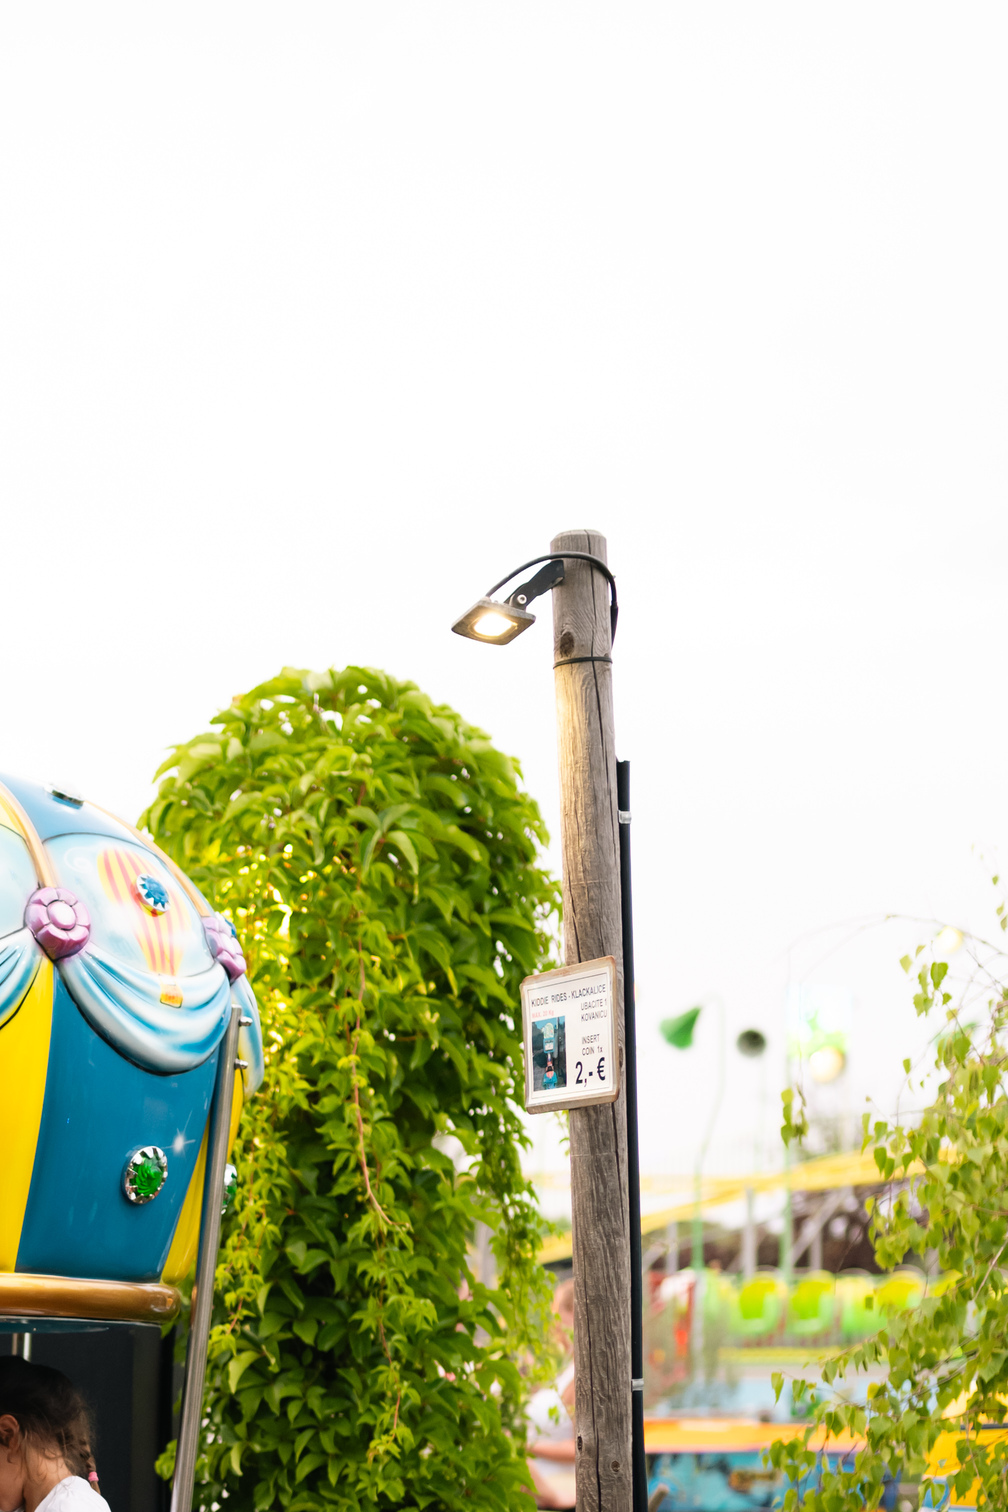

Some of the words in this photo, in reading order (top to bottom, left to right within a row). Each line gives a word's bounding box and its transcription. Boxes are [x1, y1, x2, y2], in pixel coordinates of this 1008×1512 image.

[531, 996, 549, 1007] KIDDIE
[551, 992, 567, 1003] RIDES
[571, 984, 606, 999] KLACKALICE
[580, 999, 603, 1010] UBACITE
[581, 1010, 607, 1022] KOVANICU
[581, 1034, 600, 1044] INSERT
[581, 1048, 595, 1056] COIN
[597, 1057, 606, 1081] €
